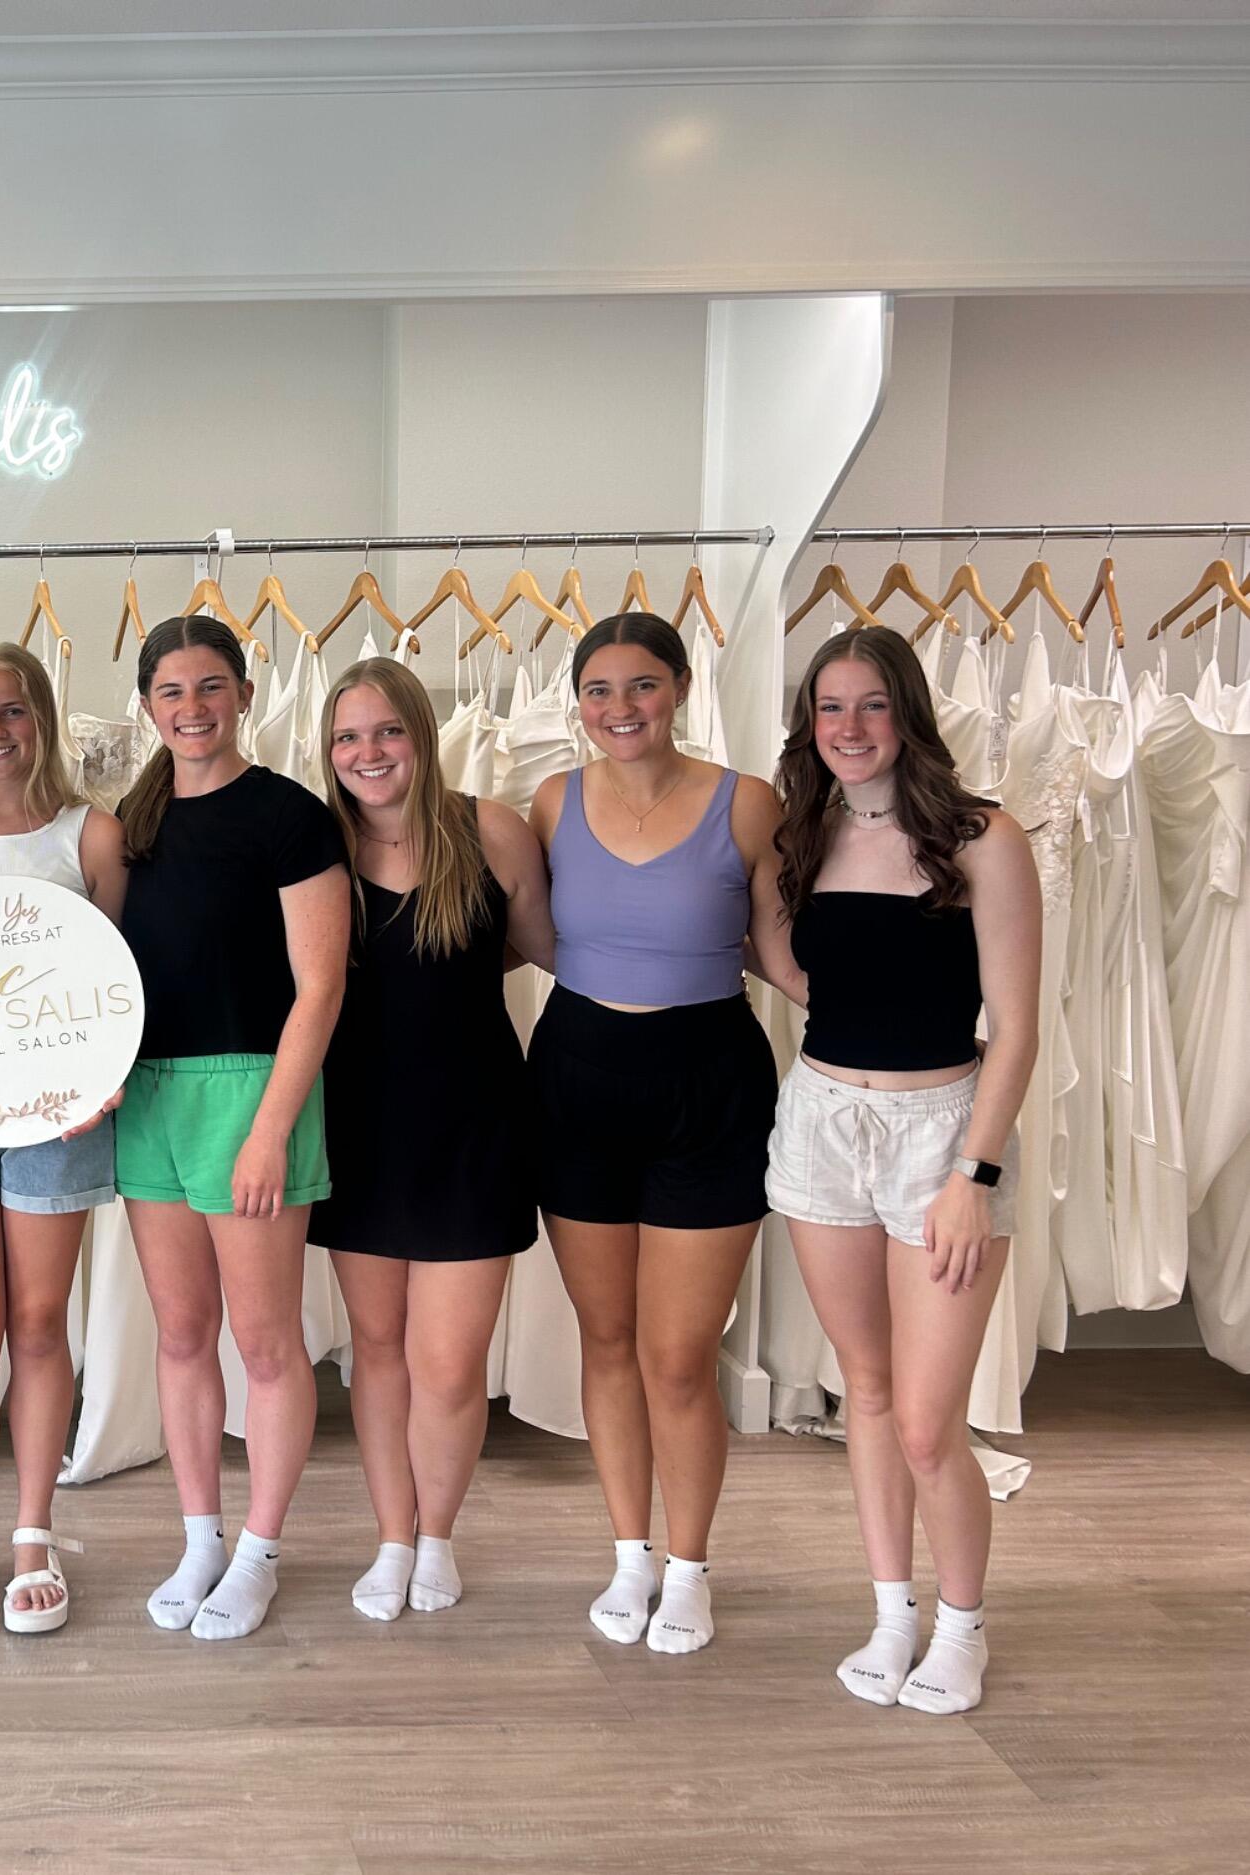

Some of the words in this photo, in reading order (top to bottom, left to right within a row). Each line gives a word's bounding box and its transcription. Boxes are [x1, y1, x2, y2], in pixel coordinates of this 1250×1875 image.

[2, 893, 41, 932] Yes
[44, 926, 63, 940] AT
[17, 1031, 88, 1051] SALON
